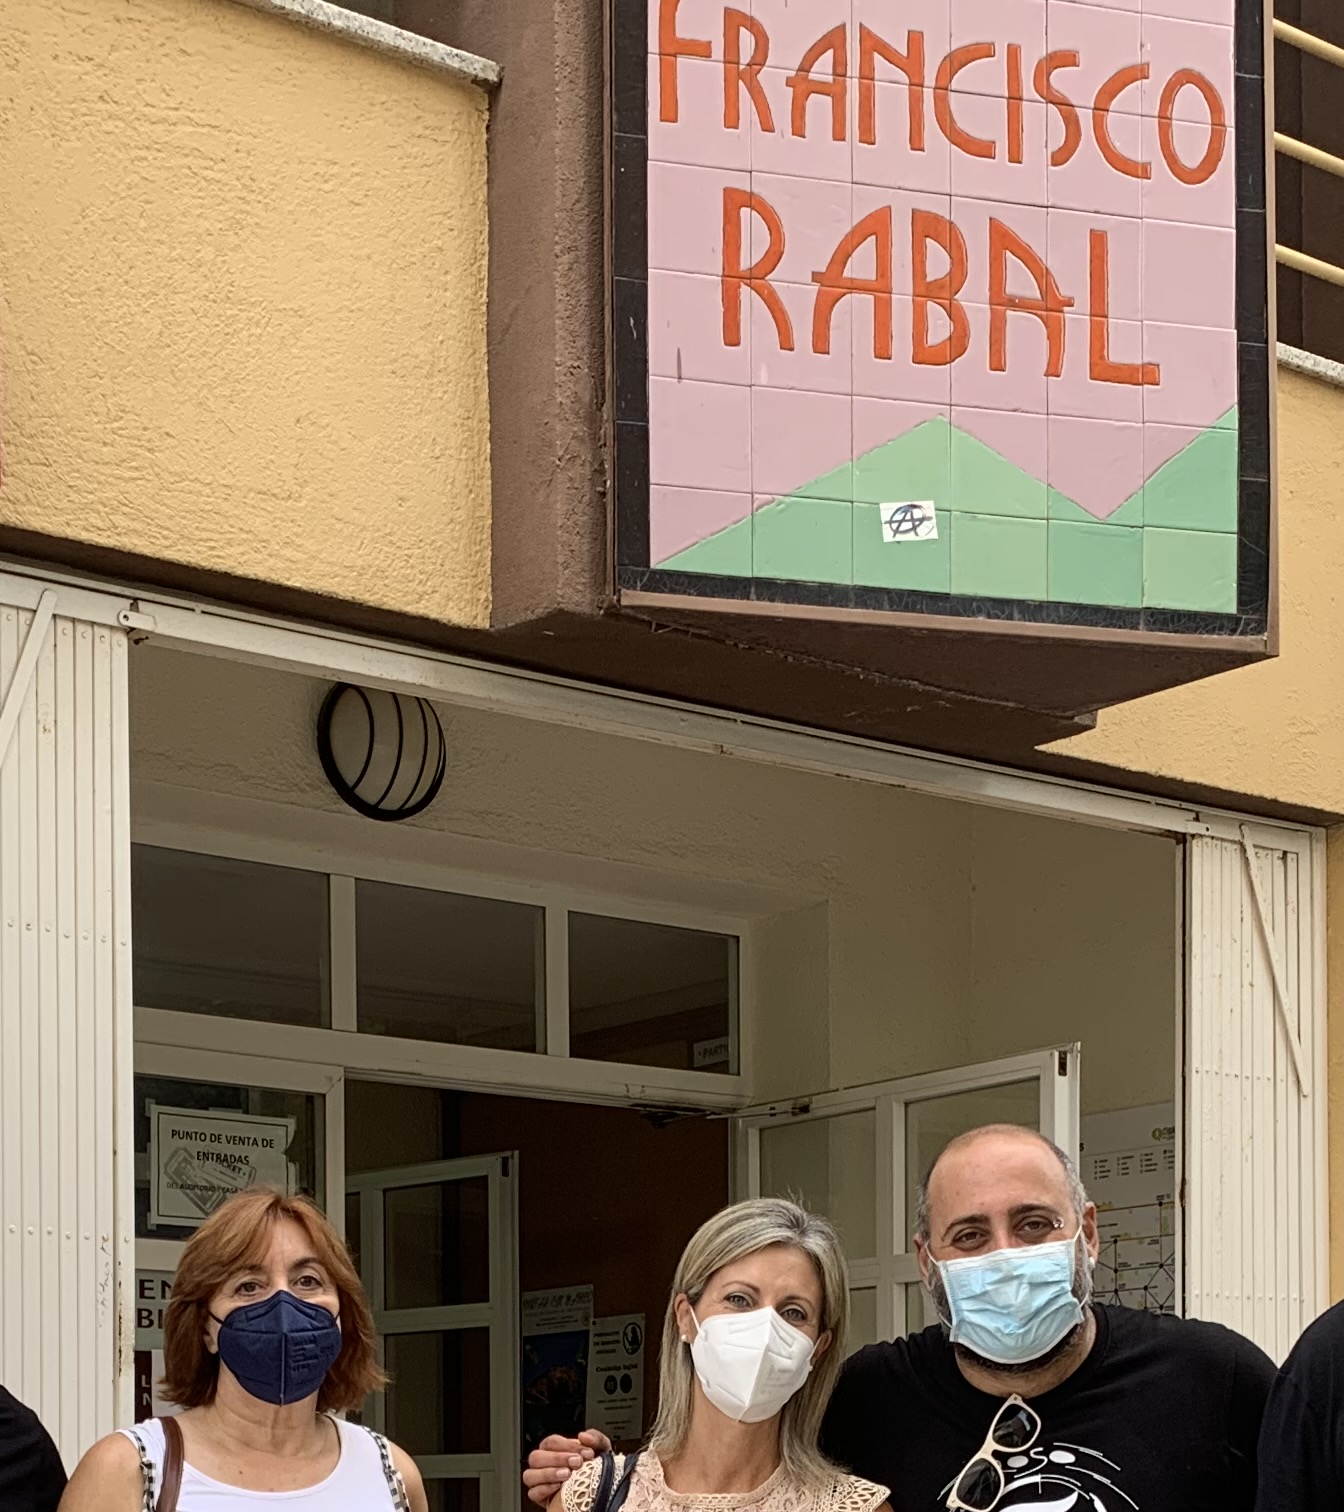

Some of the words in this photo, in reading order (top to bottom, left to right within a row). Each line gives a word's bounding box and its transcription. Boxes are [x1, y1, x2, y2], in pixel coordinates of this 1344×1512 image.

[659, 0, 1226, 184] FRANCISCO
[721, 187, 1161, 386] RABAL
[171, 1129, 206, 1142] PUNTO
[210, 1133, 223, 1144] DE
[225, 1136, 258, 1147] VENTA
[261, 1138, 274, 1149] DE
[197, 1151, 250, 1165] ENTRADAS
